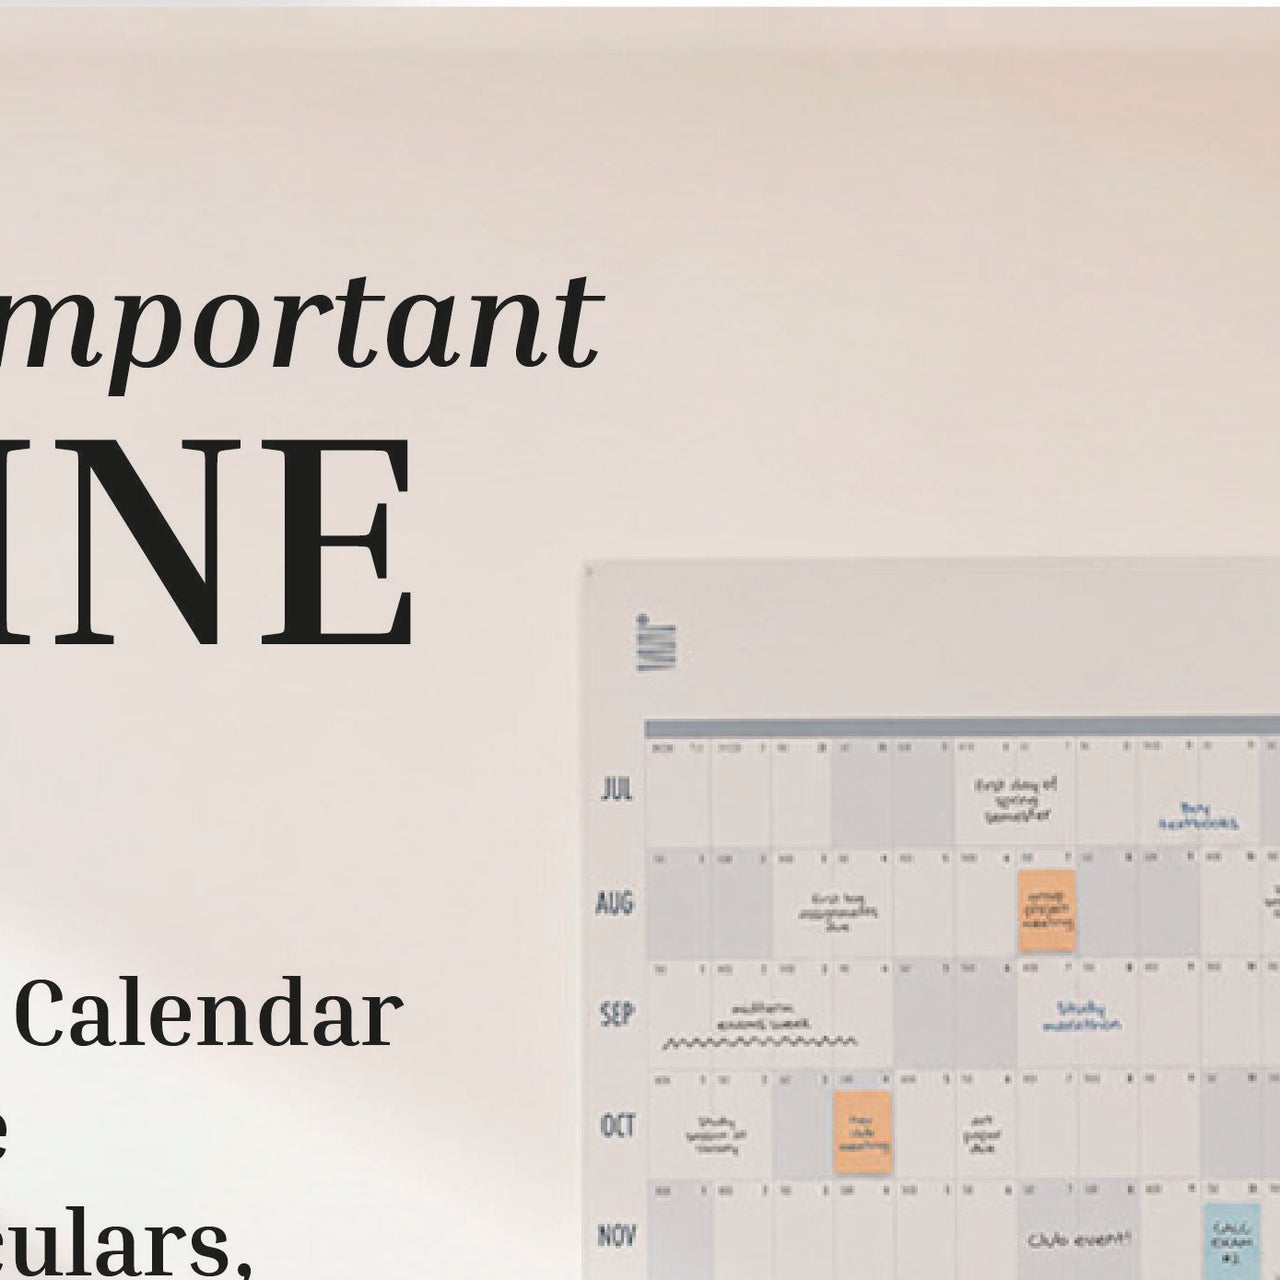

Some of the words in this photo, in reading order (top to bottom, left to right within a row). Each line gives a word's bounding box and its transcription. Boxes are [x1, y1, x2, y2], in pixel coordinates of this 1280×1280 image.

[601, 776, 632, 800] JUL
[595, 890, 635, 916] AUG
[600, 1001, 635, 1027] SEP
[600, 1113, 636, 1138] OCT
[598, 1224, 637, 1246] NOV
